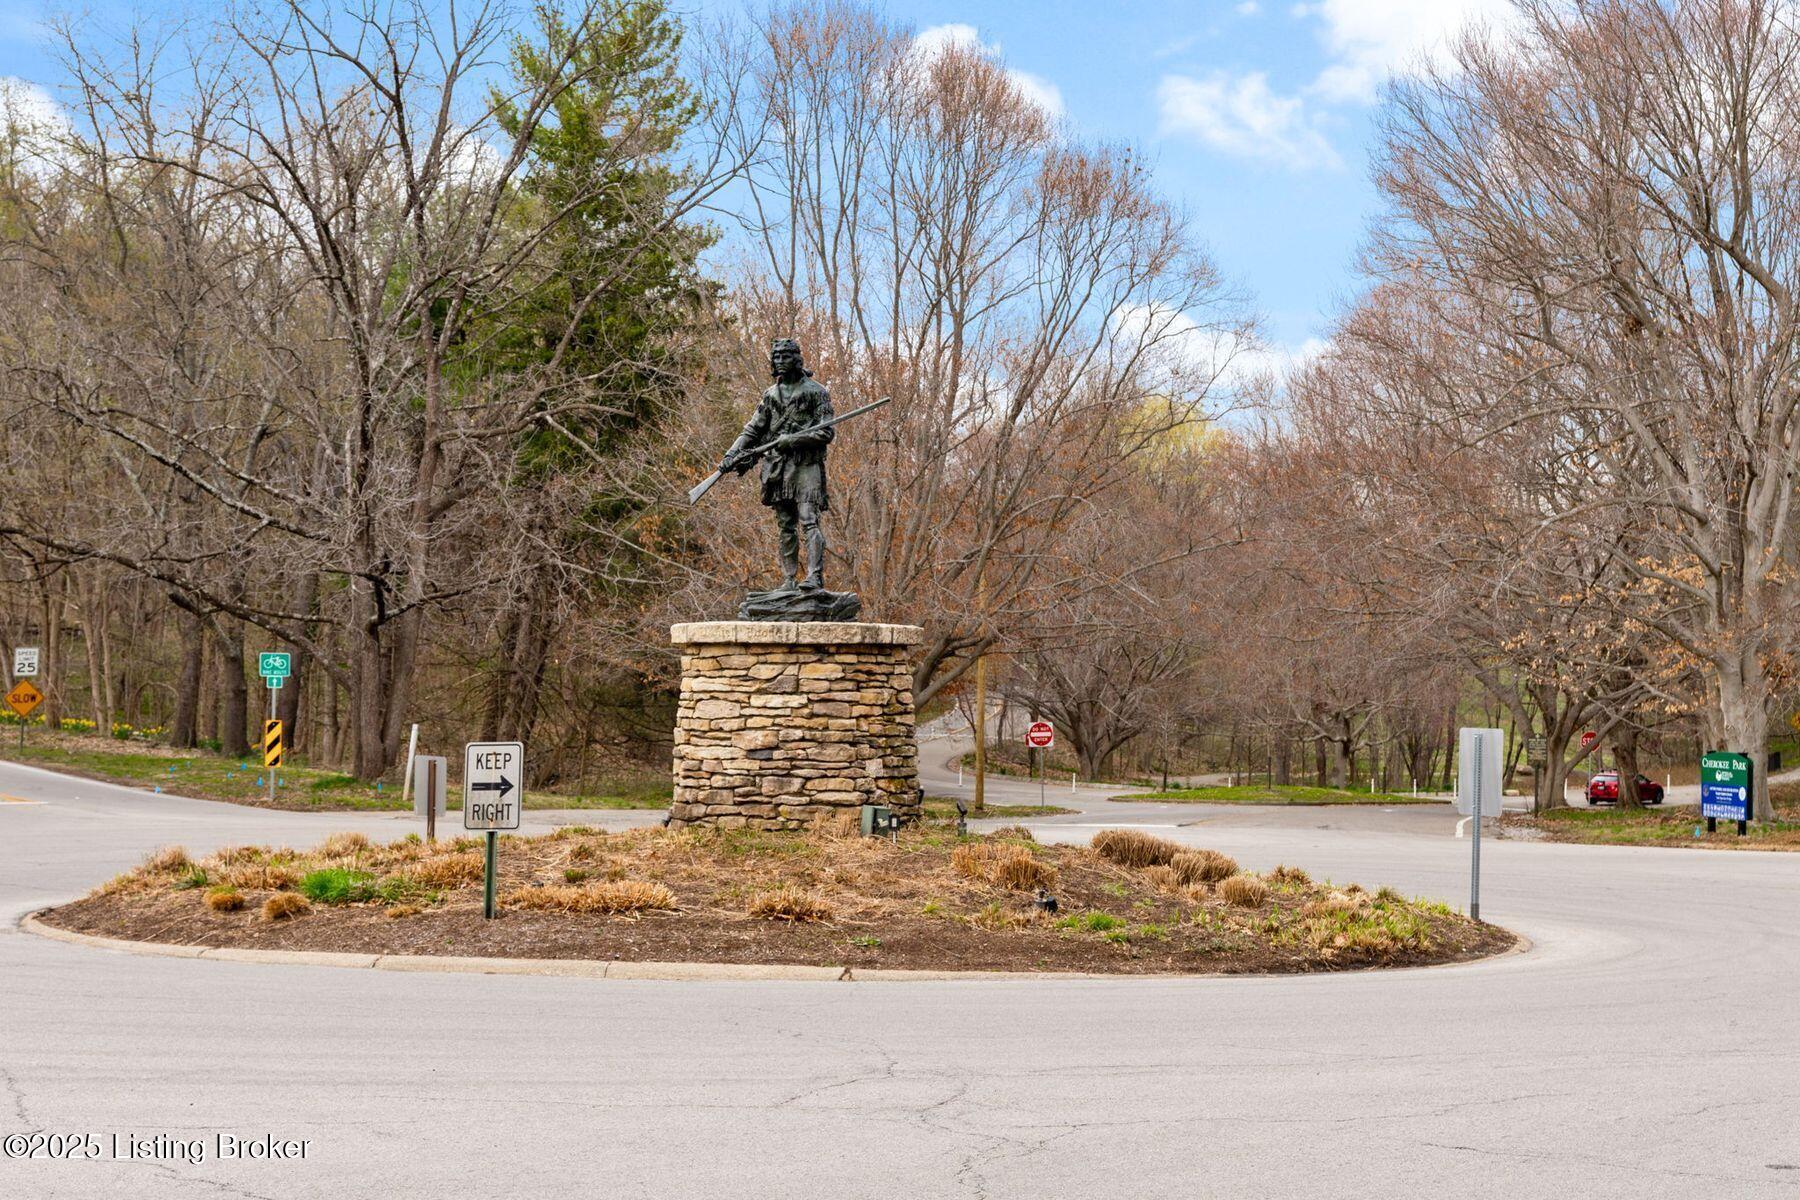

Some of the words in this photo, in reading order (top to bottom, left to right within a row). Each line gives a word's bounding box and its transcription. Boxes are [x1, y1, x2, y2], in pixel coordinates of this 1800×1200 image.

[17, 662, 36, 673] 25
[12, 693, 36, 703] SLOW
[476, 752, 512, 770] KEEP
[1732, 759, 1747, 771] PARK
[472, 803, 512, 821] RIGHT
